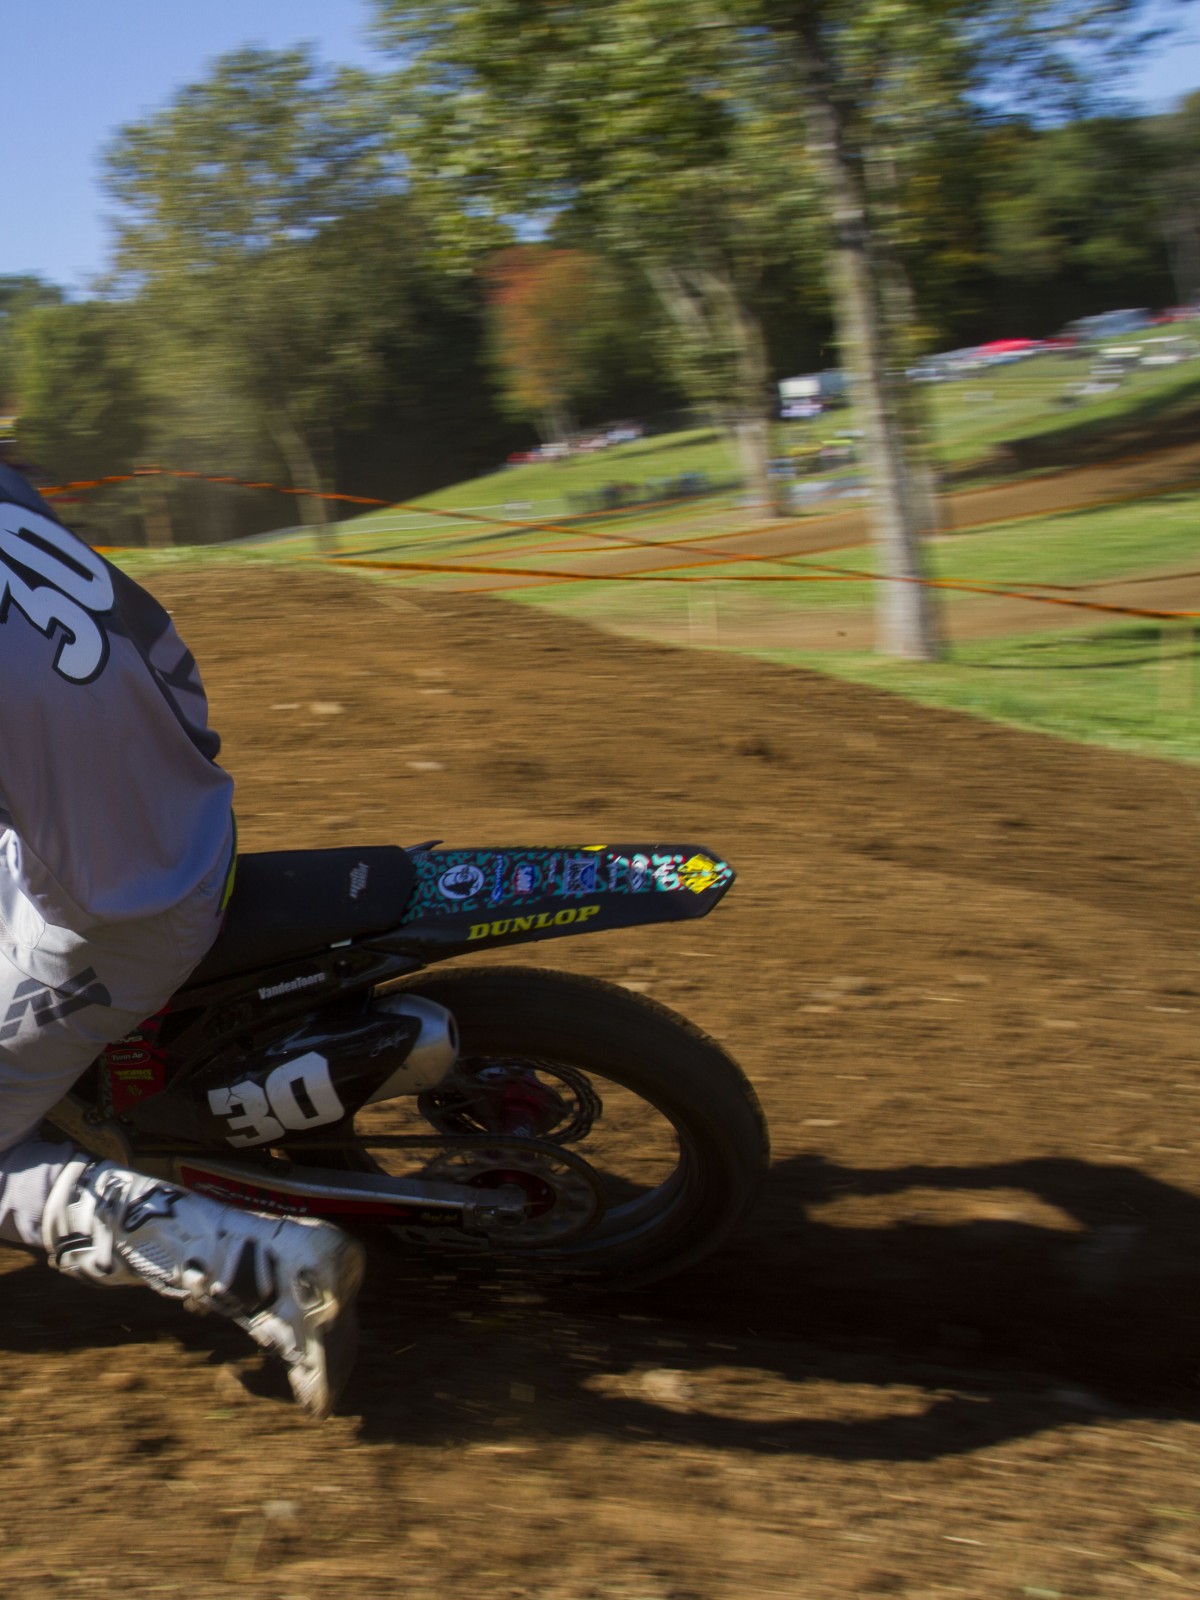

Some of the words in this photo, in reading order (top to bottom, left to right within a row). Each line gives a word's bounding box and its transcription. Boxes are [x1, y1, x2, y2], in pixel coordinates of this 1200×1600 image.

[467, 905, 600, 940] DUNLOP
[258, 972, 326, 1000] VandenToorn
[112, 1053, 131, 1061] Twin
[208, 1051, 345, 1148] 30
